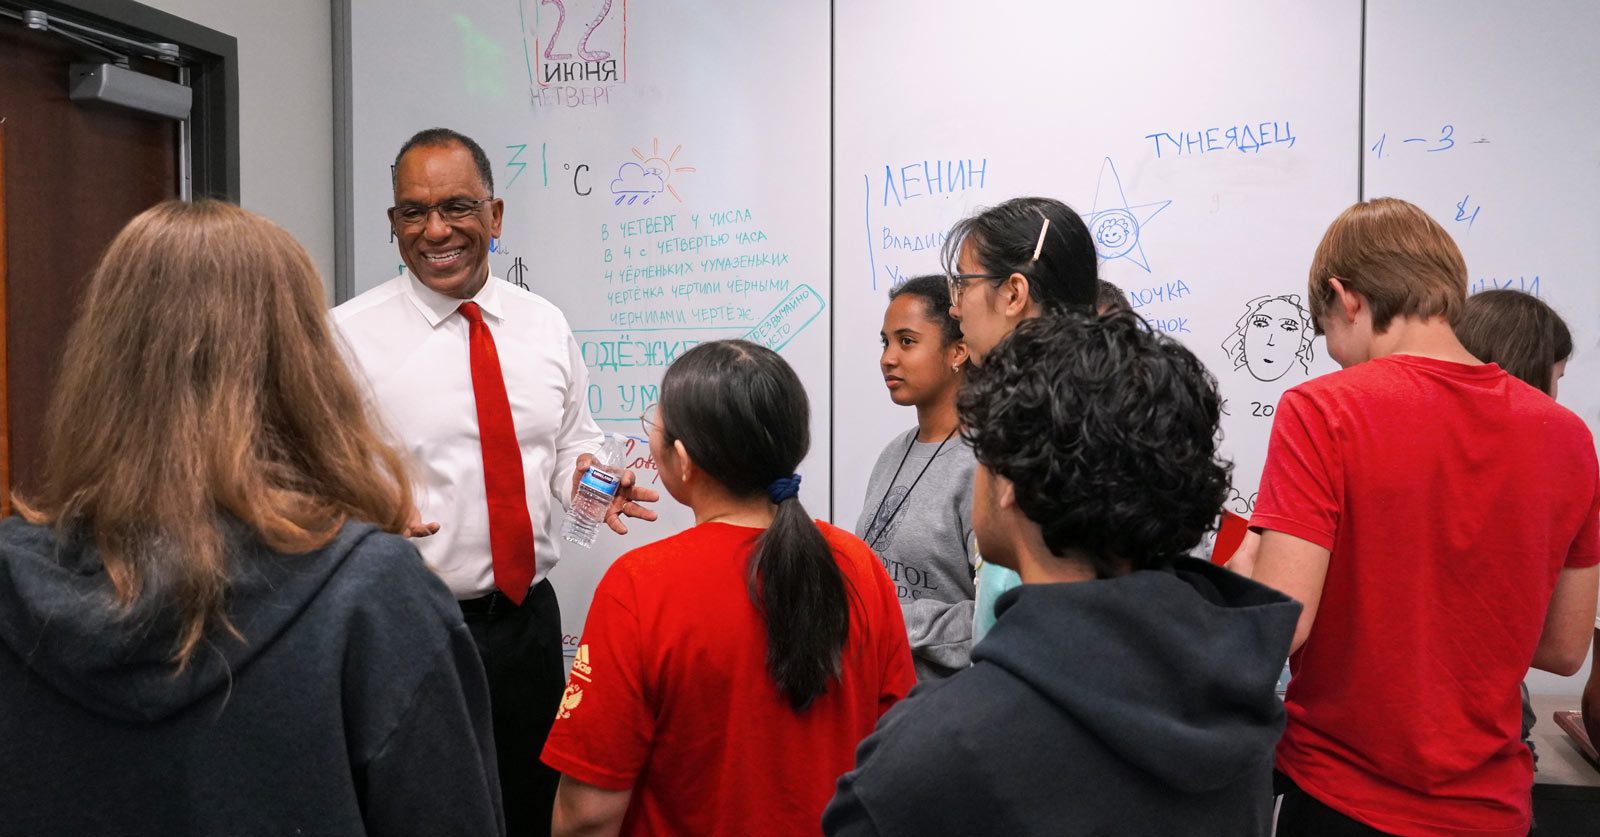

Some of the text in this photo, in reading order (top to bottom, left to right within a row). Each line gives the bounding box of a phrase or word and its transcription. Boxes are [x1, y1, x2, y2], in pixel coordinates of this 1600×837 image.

[541, 0, 612, 62] 22
[544, 60, 618, 82] ИЮНЯ
[1145, 121, 1296, 159] ТУНЕЯДЕЦ
[1426, 124, 1455, 153] 3
[505, 142, 548, 190] 31
[884, 158, 987, 207] ЛЕНИН
[601, 223, 610, 241] В
[620, 214, 677, 238] ЧЕТВЕРГ
[709, 208, 752, 228] ЧИСЛА
[604, 248, 613, 263] В
[623, 245, 631, 259] 4
[657, 233, 729, 255] ЧЕТВЕРТЬЮ
[735, 229, 768, 246] ЧАСА
[700, 252, 789, 273] ЧУМАЗЕНЬКИХ
[671, 281, 721, 302] ЧЕРТИЛИ
[1130, 279, 1191, 309] ДОЧКА
[610, 308, 688, 328] ЧЕРНИЛАМИ
[752, 290, 810, 341] РЕЗВЫЧАЙНО
[617, 384, 660, 413] УМ
[882, 556, 938, 591] PITOL
[573, 659, 593, 675] das
